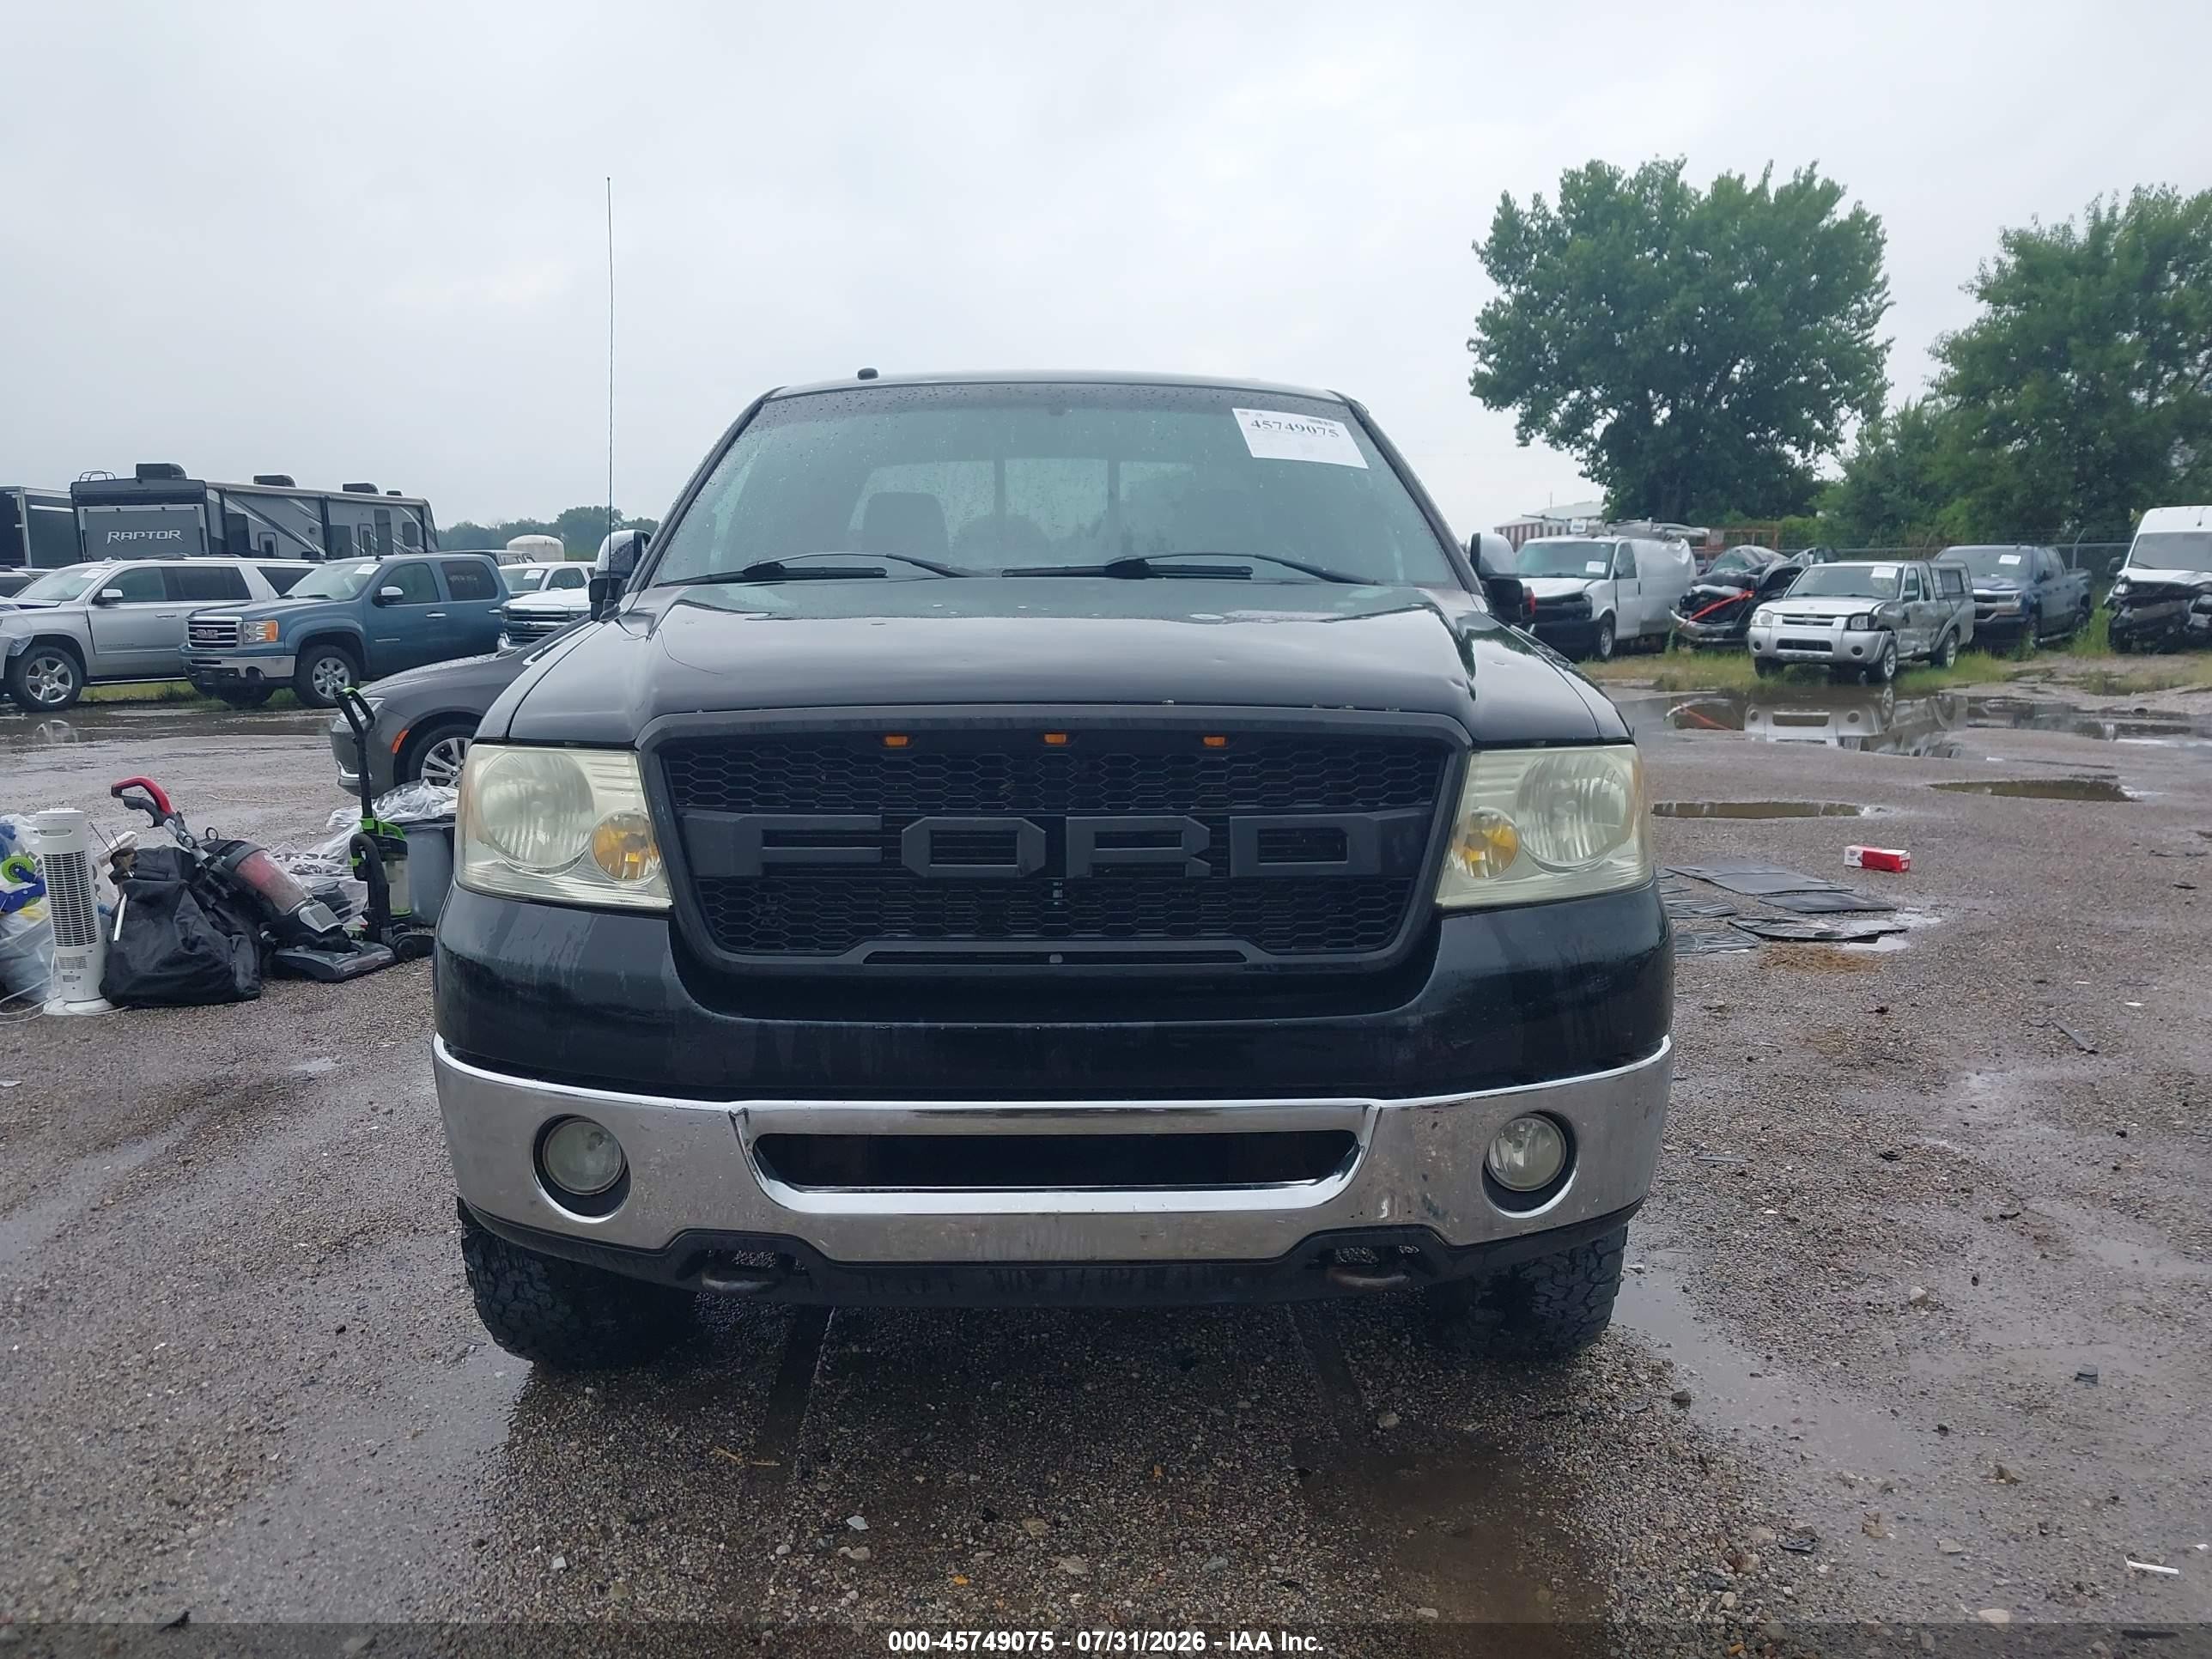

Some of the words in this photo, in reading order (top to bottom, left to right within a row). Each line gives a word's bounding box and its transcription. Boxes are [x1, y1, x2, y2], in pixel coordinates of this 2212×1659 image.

[1250, 419, 1340, 438] 45749075
[106, 530, 185, 544] RAPTOR
[684, 813, 1386, 878] FORD
